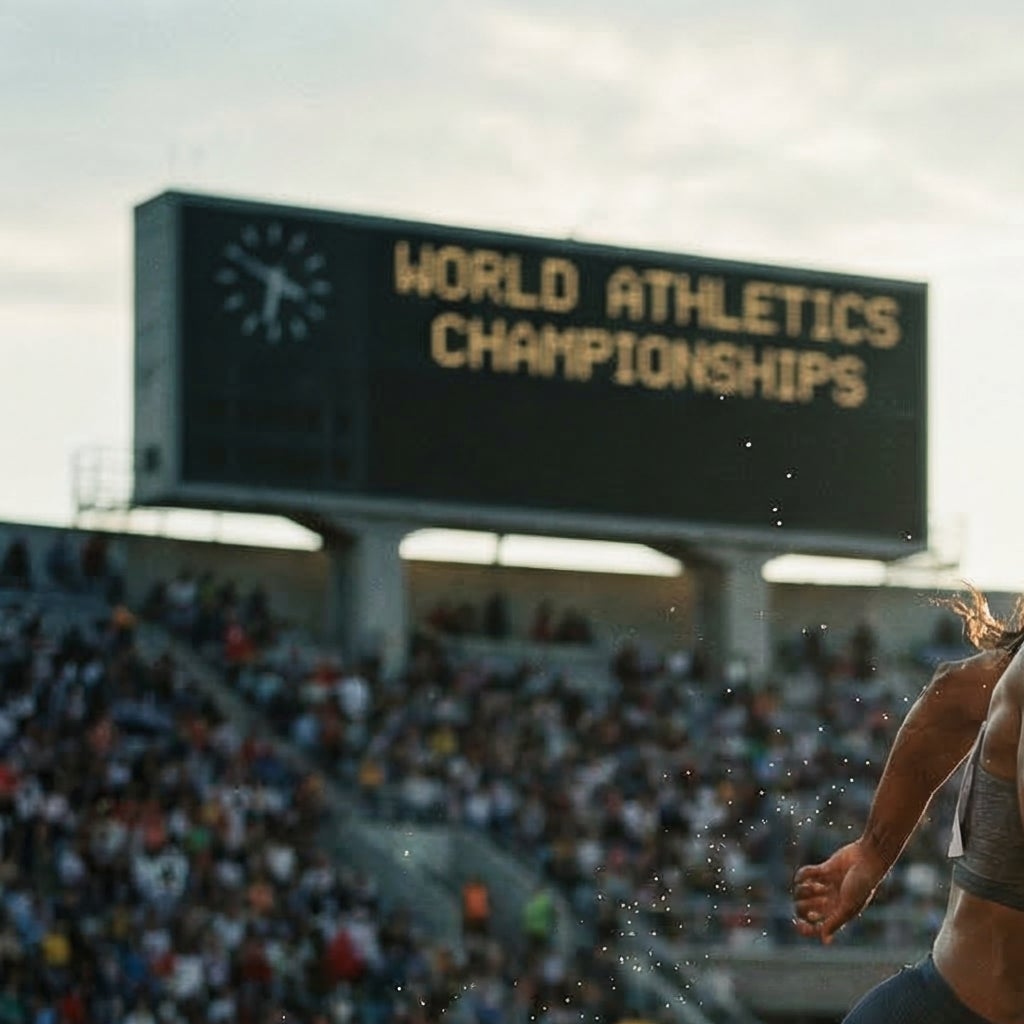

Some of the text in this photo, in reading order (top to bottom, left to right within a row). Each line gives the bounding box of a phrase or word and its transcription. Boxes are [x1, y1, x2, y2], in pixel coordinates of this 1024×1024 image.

[394, 240, 901, 348] WORLD ATHLETICS
[431, 312, 867, 408] CHAMPIONSHIPS
